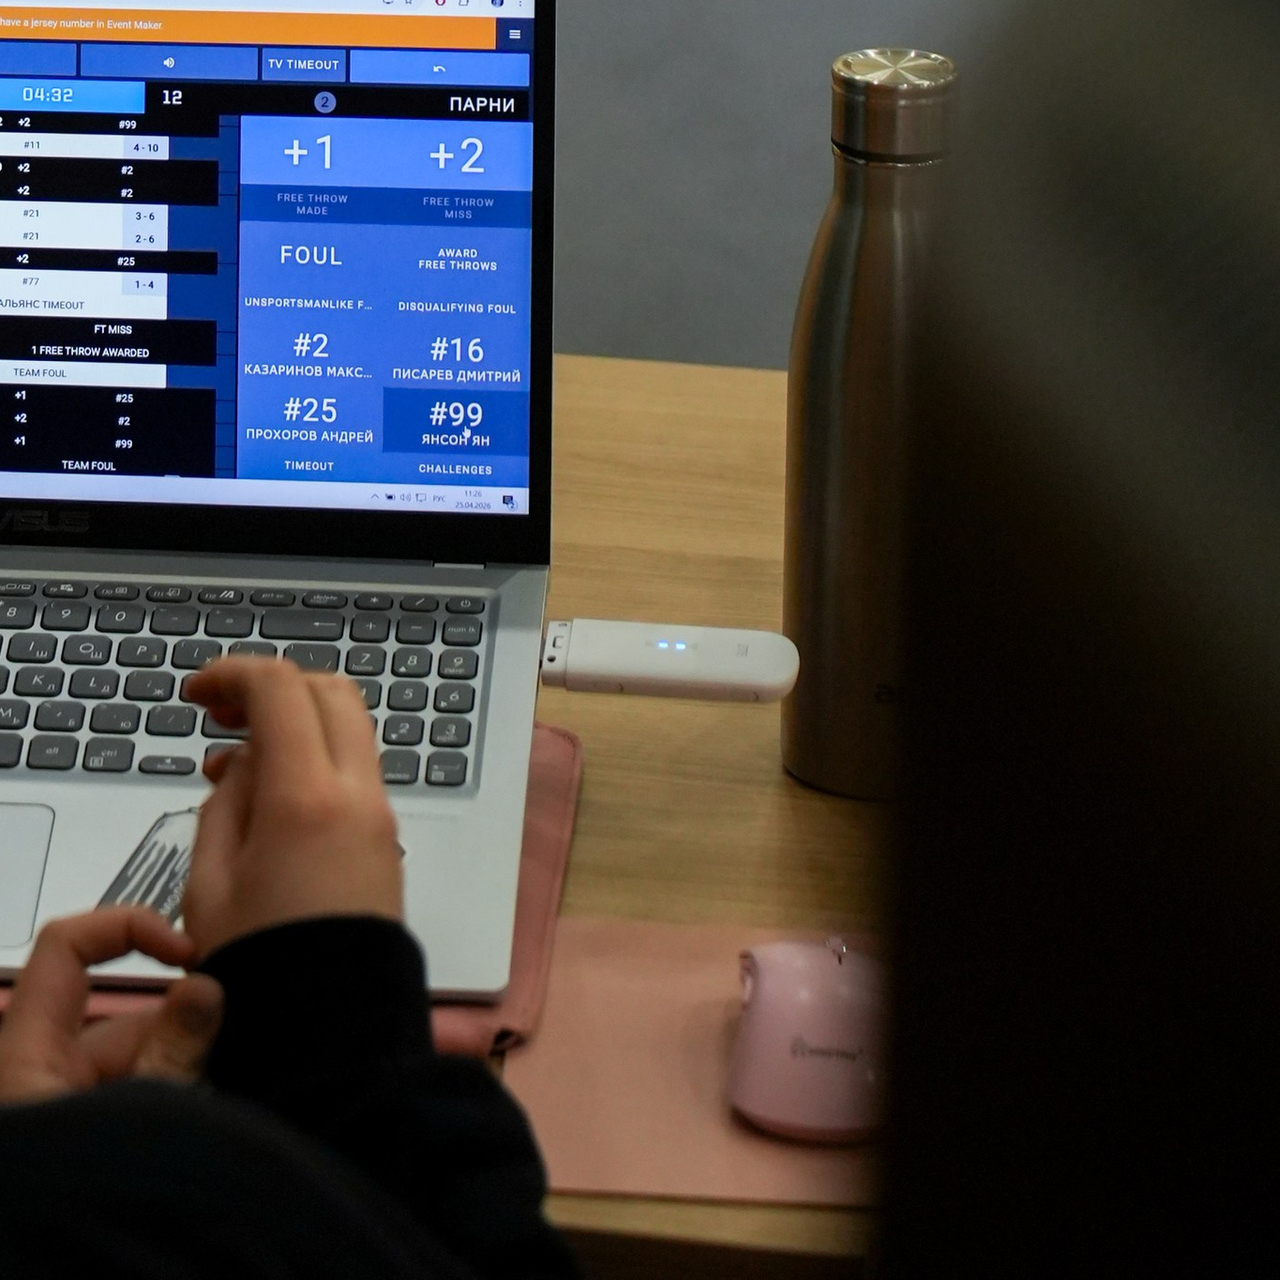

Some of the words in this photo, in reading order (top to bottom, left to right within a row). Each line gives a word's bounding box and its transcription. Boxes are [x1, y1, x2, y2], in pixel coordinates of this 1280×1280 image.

[0, 17, 20, 26] have
[31, 18, 57, 28] jersey
[60, 19, 93, 27] number
[107, 20, 131, 28] Event
[269, 59, 283, 69] TV
[287, 59, 339, 70] TIMEOUT
[23, 88, 73, 102] 04:32
[163, 90, 182, 104] 12
[322, 96, 329, 108] 2
[450, 97, 515, 113] ПАРНИ
[19, 117, 30, 126] +2
[119, 120, 136, 129] #99
[24, 141, 40, 150] #11
[284, 135, 331, 169] +1
[430, 138, 484, 173] +2
[18, 163, 30, 172] +2
[122, 166, 133, 175] #2
[18, 186, 29, 195] +2
[122, 189, 133, 198] #2
[277, 193, 303, 202] FREE
[308, 194, 348, 203] THROW
[423, 197, 449, 206] FREE
[454, 198, 494, 207] THROW
[23, 209, 39, 218] #21
[297, 206, 327, 215] MADE
[445, 210, 472, 219] MISS
[23, 232, 39, 241] #21
[281, 246, 342, 265] FOUL
[438, 248, 478, 257] AWARD
[17, 254, 29, 263] +2
[118, 257, 135, 266] #25
[419, 260, 445, 269] FREE
[450, 261, 497, 271] THROWS
[23, 277, 39, 286] #77
[43, 300, 84, 310] TIMEOUT
[245, 298, 353, 309] UNSPORTSMANLIKE
[399, 302, 483, 313] DISQUALIFYING
[488, 304, 516, 314] FOUL
[95, 325, 106, 334] FT
[109, 325, 132, 335] MISS
[293, 333, 329, 358] #2
[430, 337, 484, 362] #16
[40, 346, 63, 355] FREE
[65, 347, 100, 356] THROW
[103, 348, 149, 357] AWARDED
[14, 368, 40, 377] TEAM
[43, 369, 66, 378] FOUL
[244, 364, 322, 377] КАЗАРИНОВ
[393, 369, 453, 381] ПИСАРЕВ
[457, 369, 521, 383] ДМИТРИЙ
[15, 390, 26, 399] +1
[116, 394, 133, 403] #25
[283, 397, 337, 422] #25
[430, 402, 482, 427] #99
[15, 413, 27, 422] +2
[118, 417, 130, 426] #2
[15, 436, 25, 445] +1
[247, 429, 317, 441] ПРОХОРОВ
[321, 429, 373, 443] АНДРЕЙ
[422, 434, 467, 446] ЯНСОН
[472, 435, 490, 446] ЯН
[116, 440, 132, 449] #99
[62, 460, 89, 470] TEAM
[92, 461, 116, 471] FOUL
[285, 461, 333, 470] TIMEOUT
[419, 464, 492, 475] CHALLENGES
[455, 501, 491, 510] 25.04.2026
